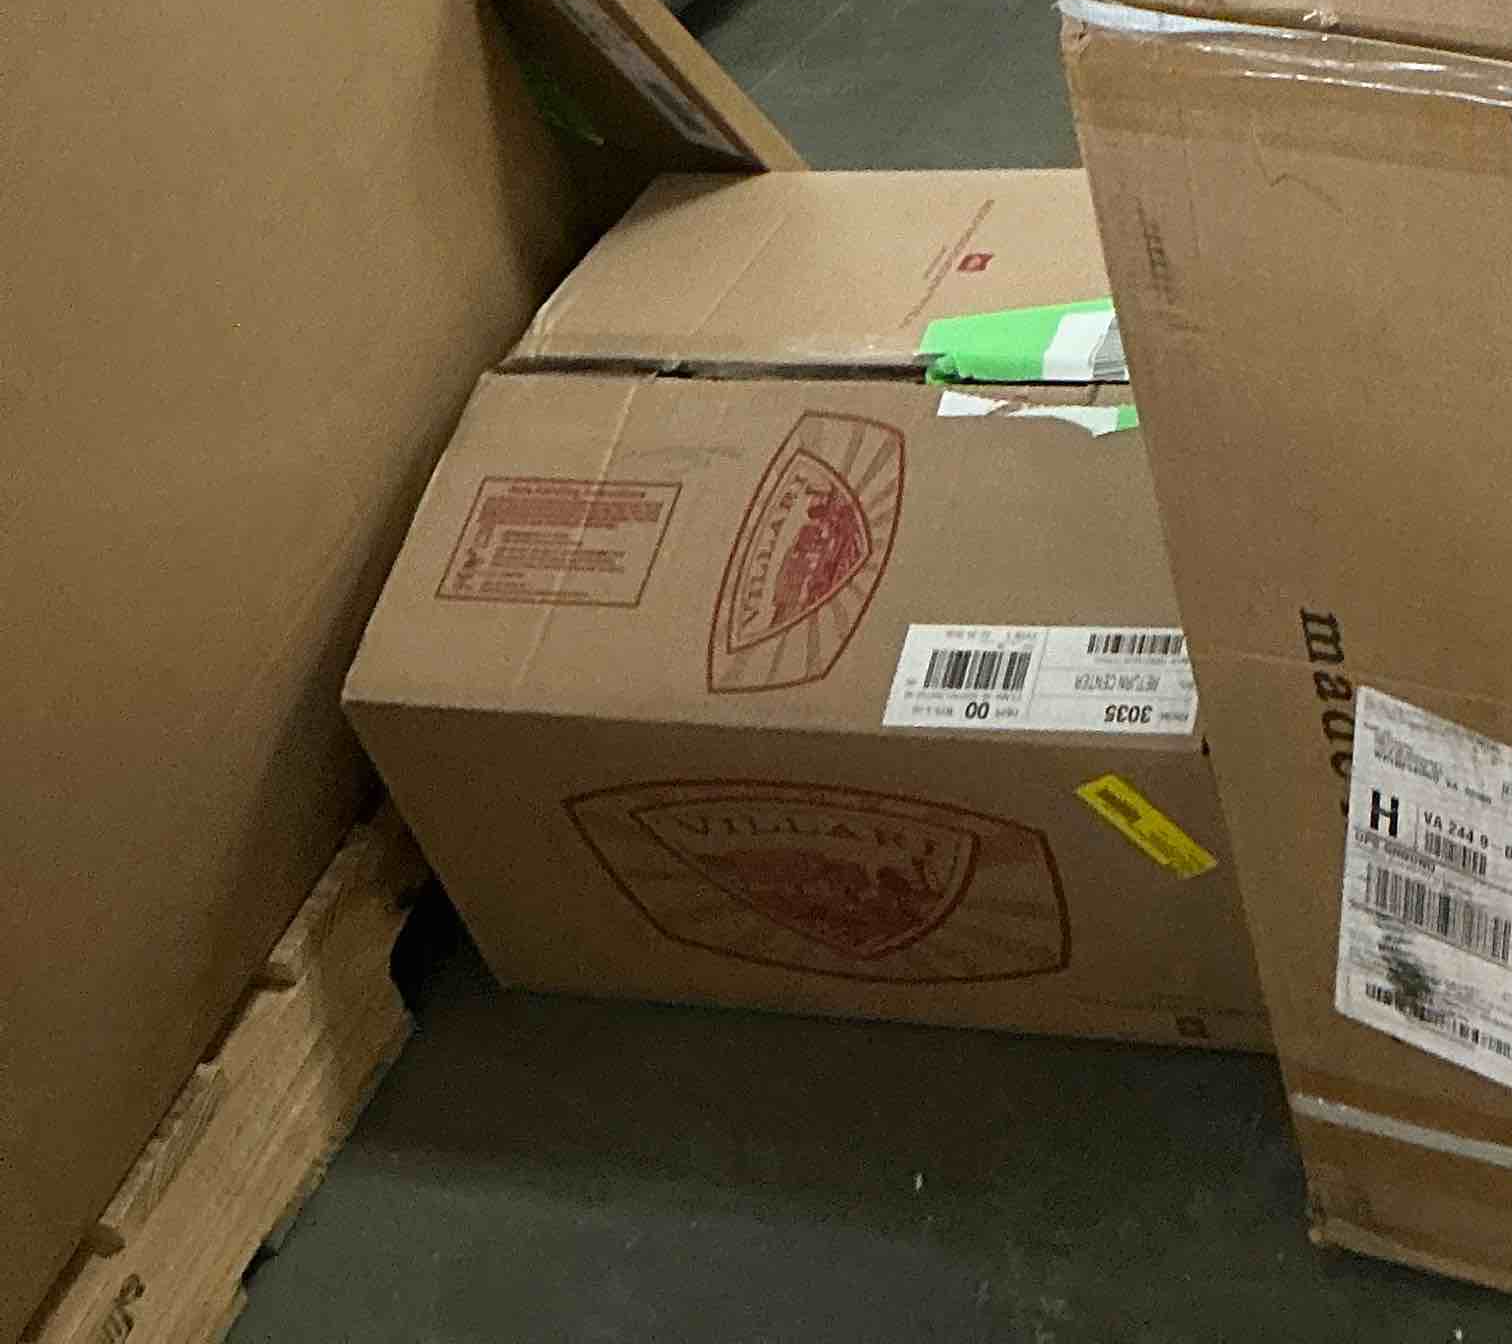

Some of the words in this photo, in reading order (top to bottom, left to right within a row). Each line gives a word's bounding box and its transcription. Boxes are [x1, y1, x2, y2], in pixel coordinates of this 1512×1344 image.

[964, 701, 990, 720] 00
[1104, 704, 1153, 724] 3035
[1369, 788, 1399, 838] H
[1423, 811, 1442, 830] VA
